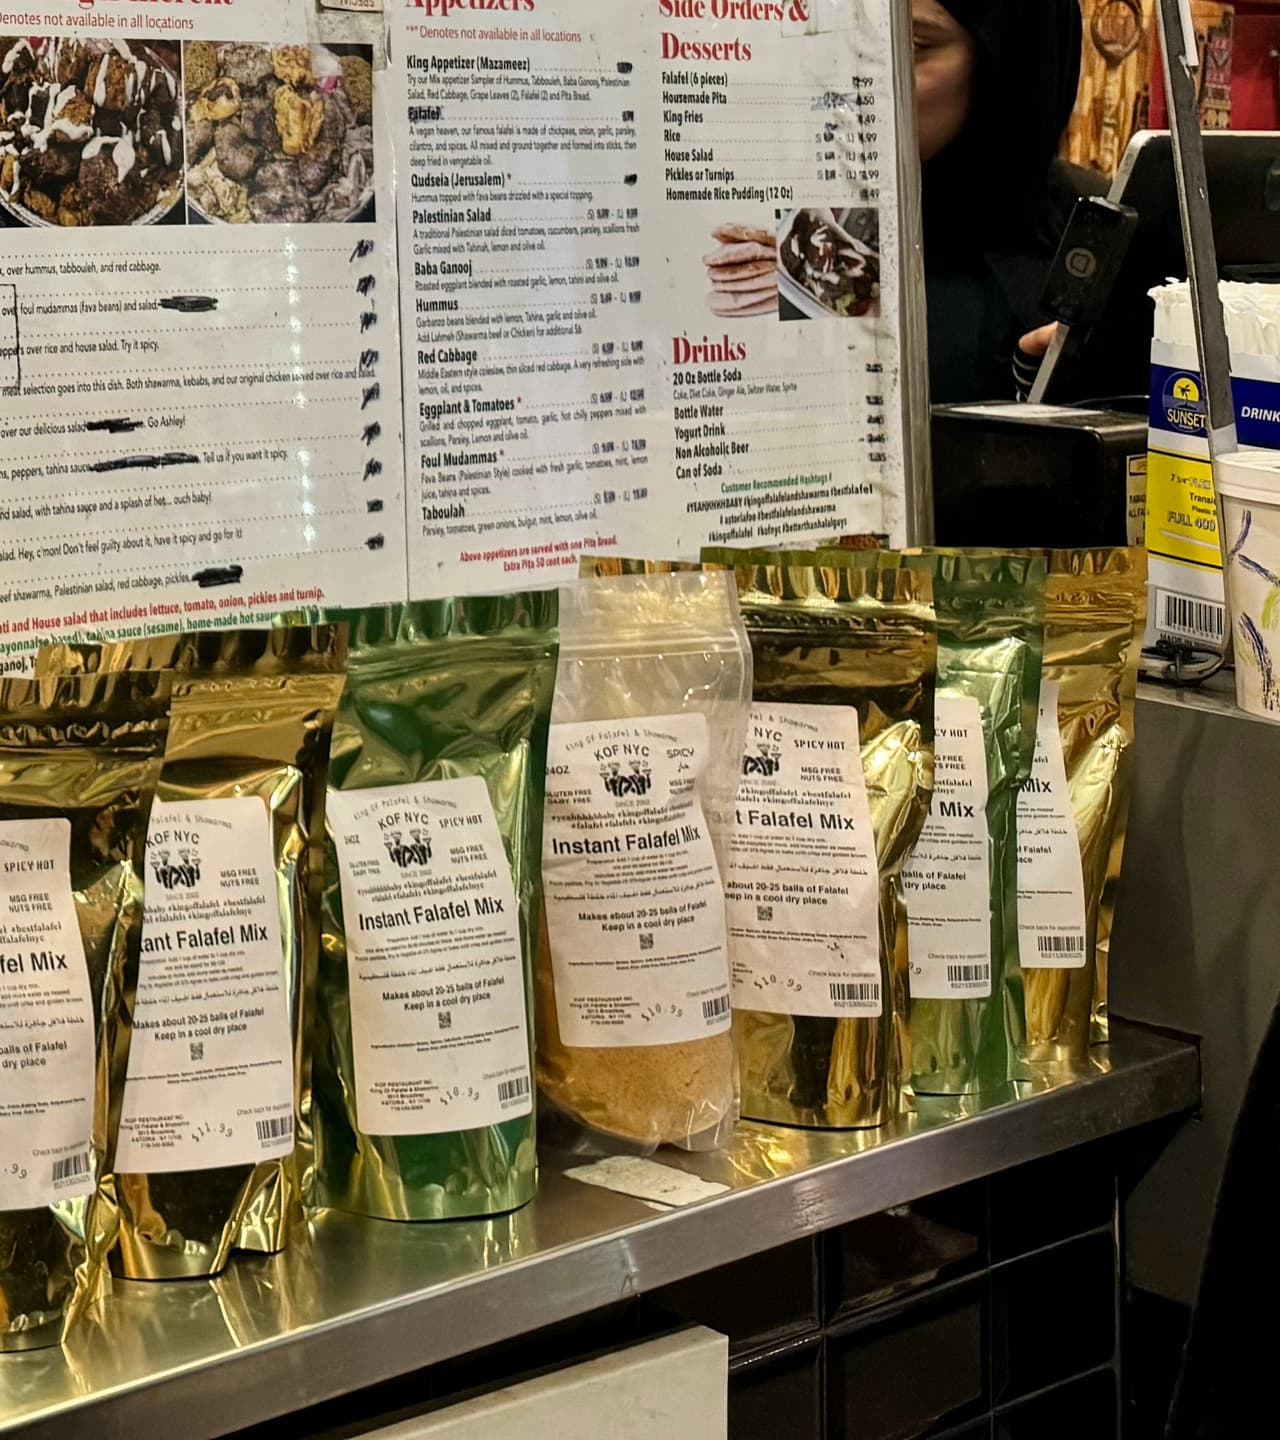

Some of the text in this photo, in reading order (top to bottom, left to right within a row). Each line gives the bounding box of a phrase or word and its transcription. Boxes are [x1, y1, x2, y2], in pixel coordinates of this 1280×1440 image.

[660, 32, 752, 61] Desserts
[664, 149, 714, 163] House Salad
[672, 334, 746, 366] Drinks
[1167, 410, 1207, 429] SUNSET
[552, 823, 700, 857] Instant Falafel Mix
